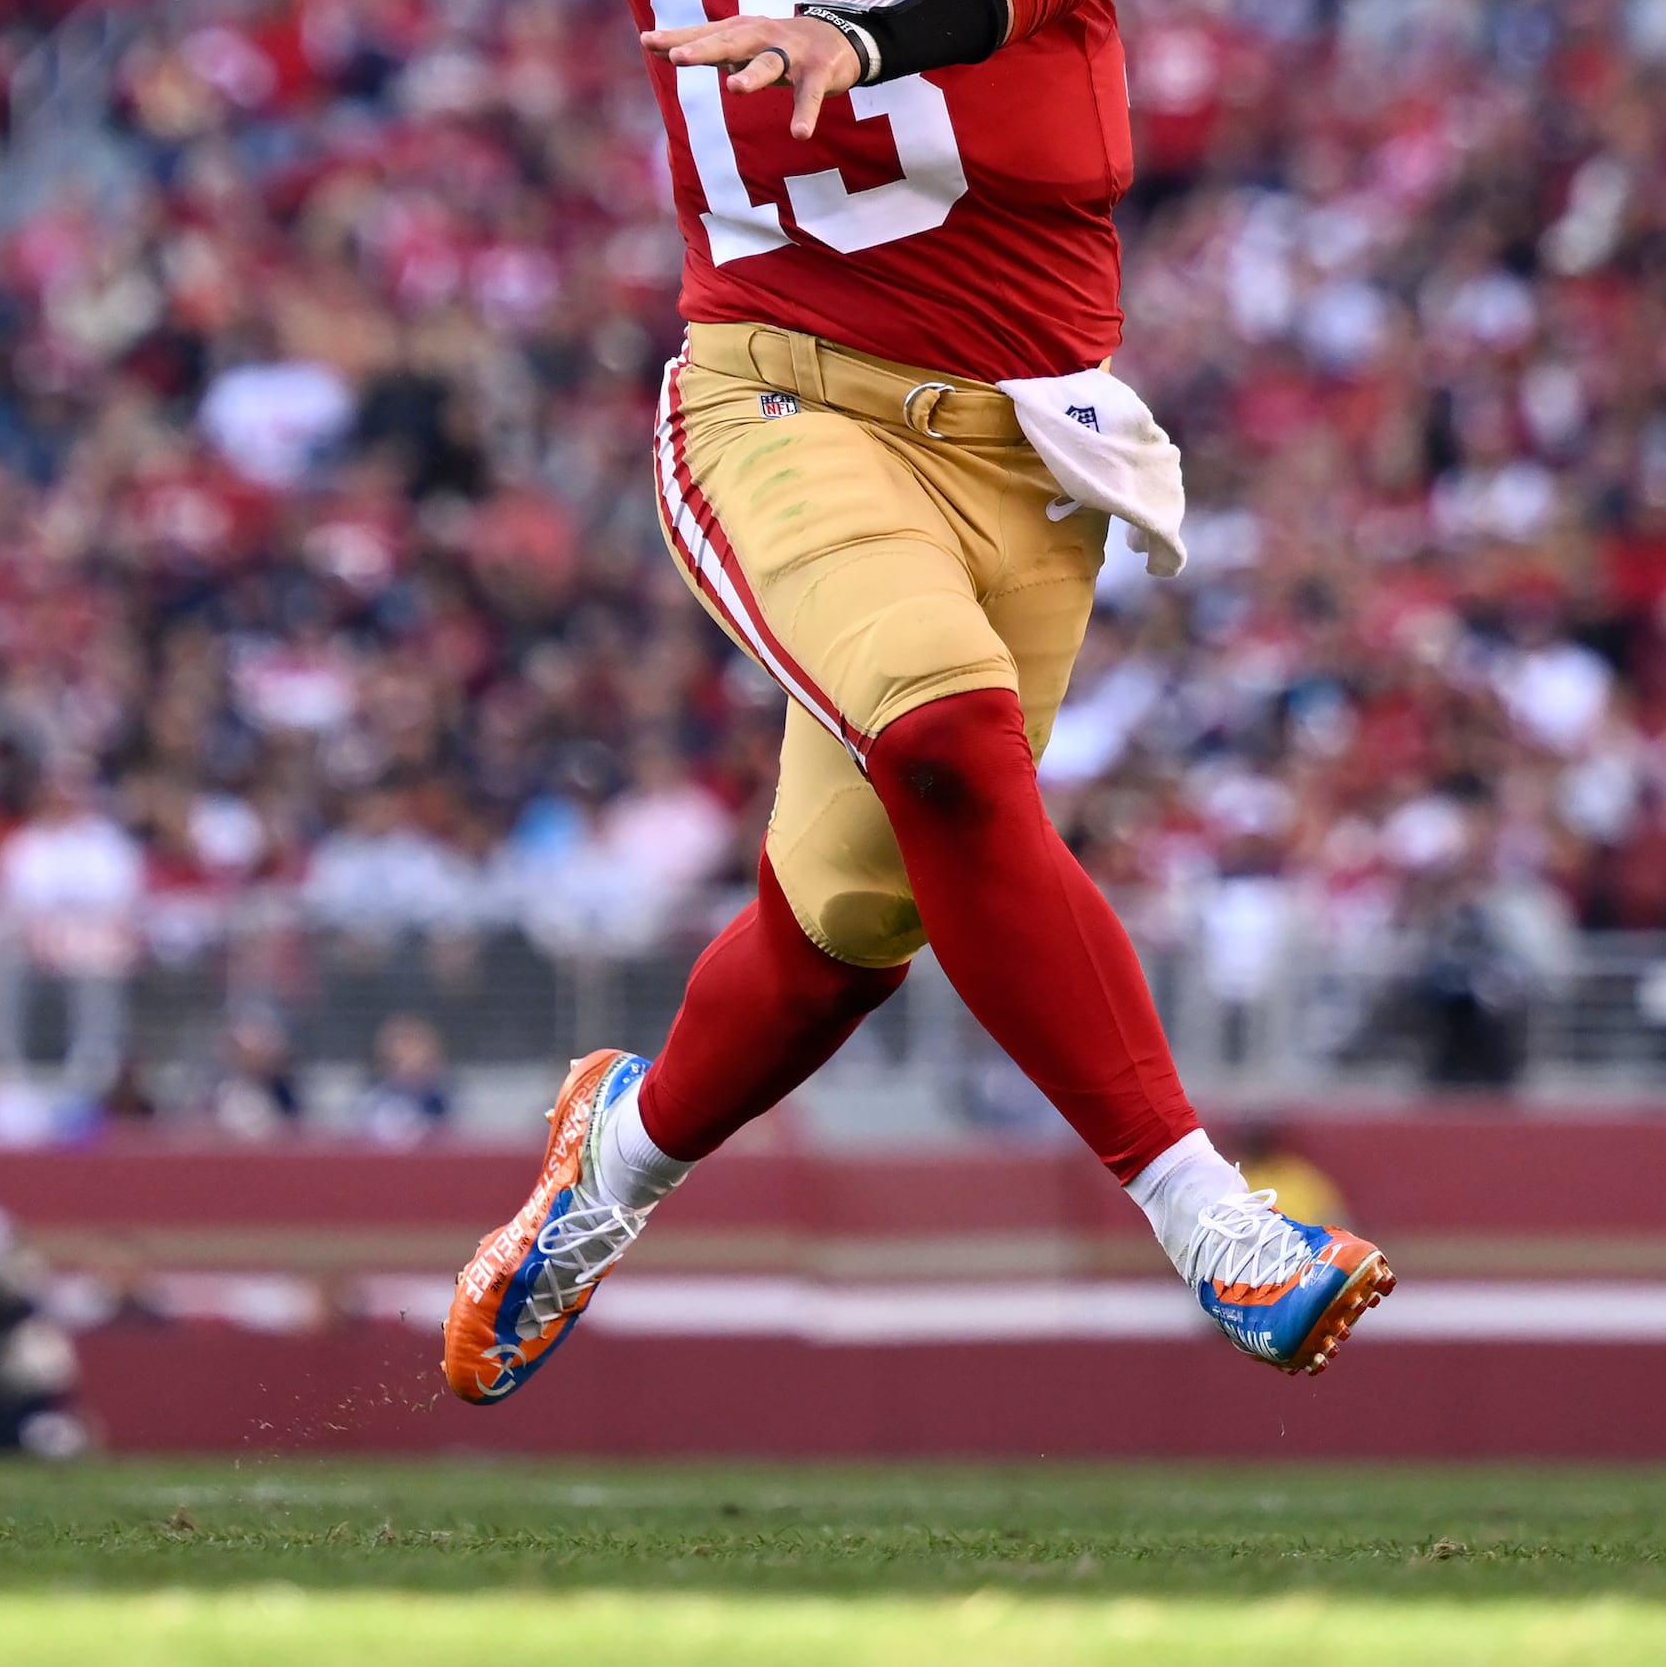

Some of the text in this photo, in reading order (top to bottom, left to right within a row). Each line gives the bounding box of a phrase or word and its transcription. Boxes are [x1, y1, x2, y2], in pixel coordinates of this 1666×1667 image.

[765, 402, 795, 416] NFL
[522, 1098, 590, 1221] DISASTER
[466, 1218, 524, 1304] RELIEF
